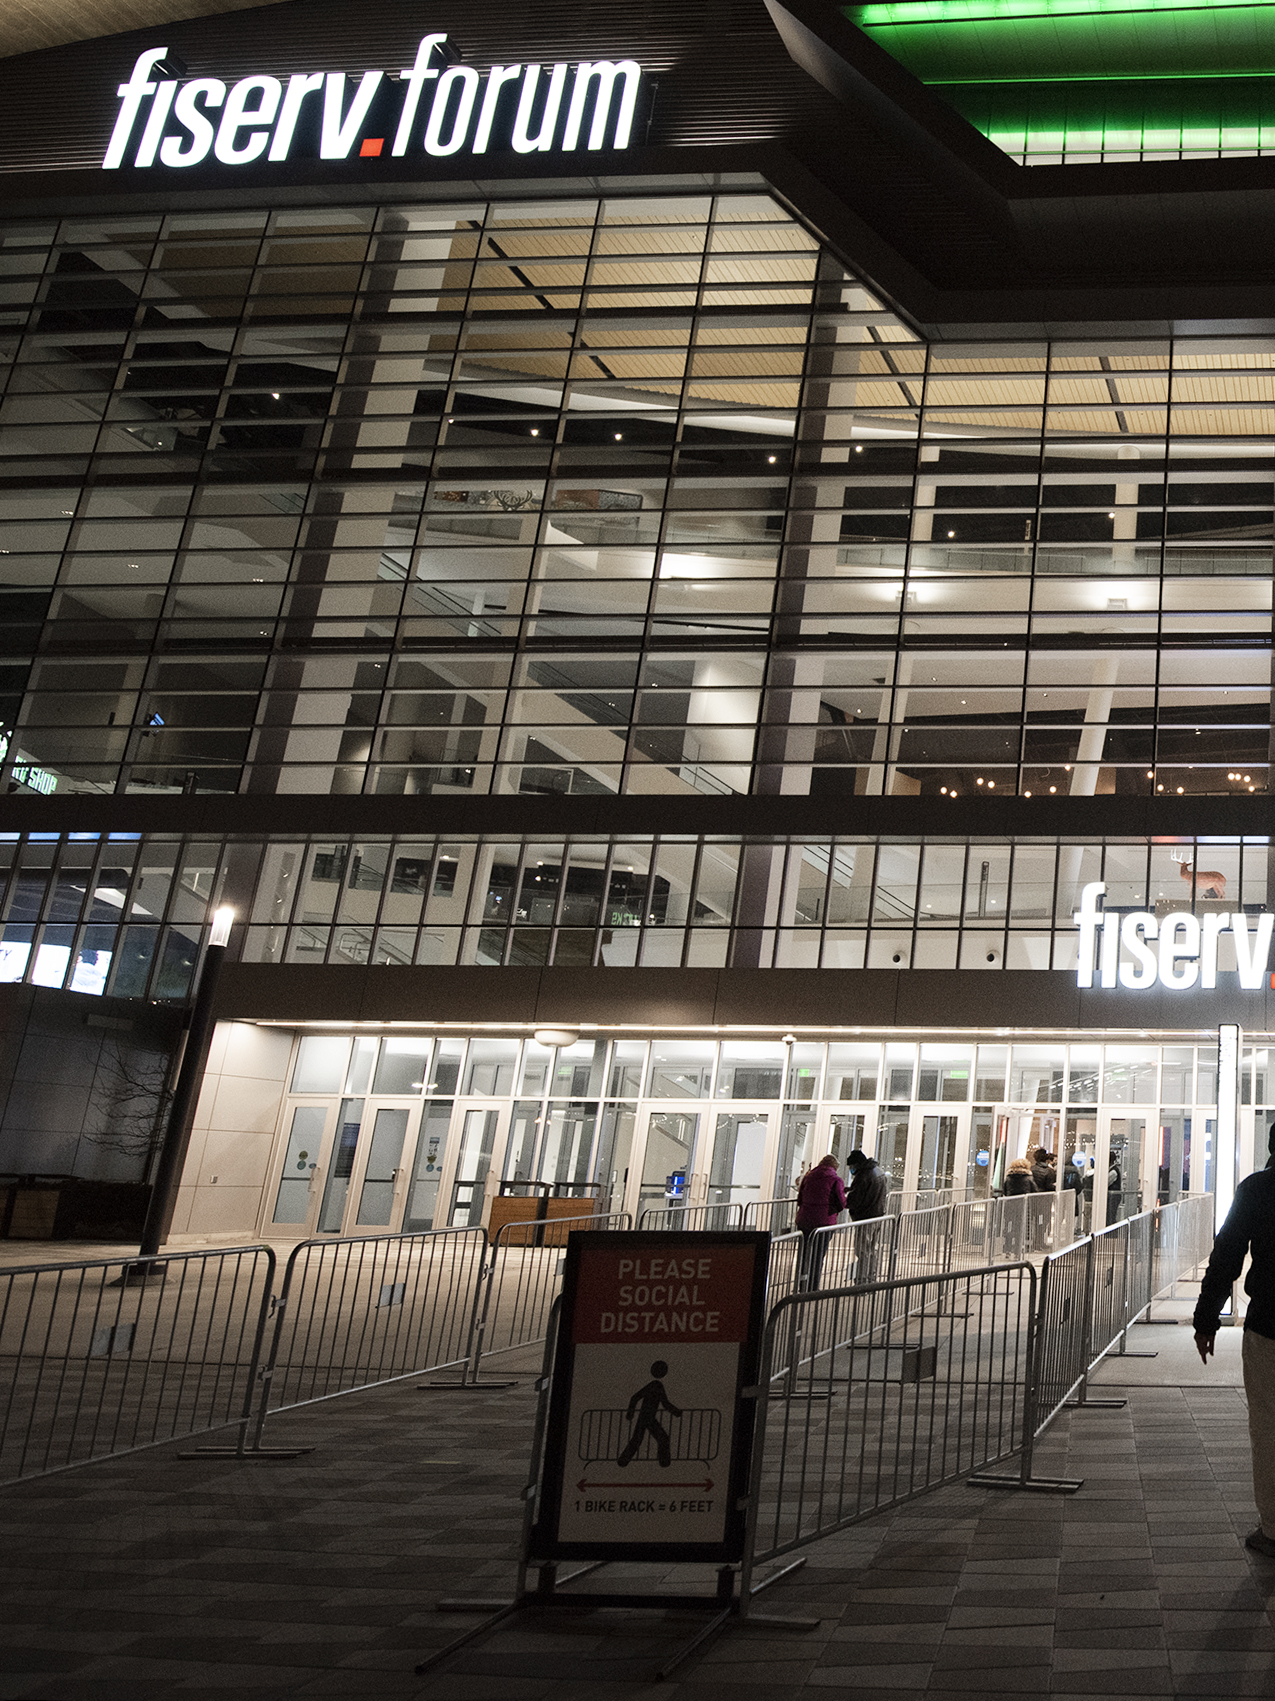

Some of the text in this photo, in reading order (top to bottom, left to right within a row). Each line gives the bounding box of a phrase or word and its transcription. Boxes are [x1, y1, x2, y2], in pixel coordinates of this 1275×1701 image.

[27, 766, 58, 795] SHOP
[619, 1259, 711, 1279] PLEASE
[618, 1285, 706, 1306] SOCIAL
[601, 1311, 720, 1333] DISTANCE
[575, 1500, 581, 1513] 1
[585, 1500, 616, 1513] BIKE
[620, 1500, 655, 1513] RACK
[669, 1500, 677, 1513] 6
[680, 1500, 714, 1513] FEET
